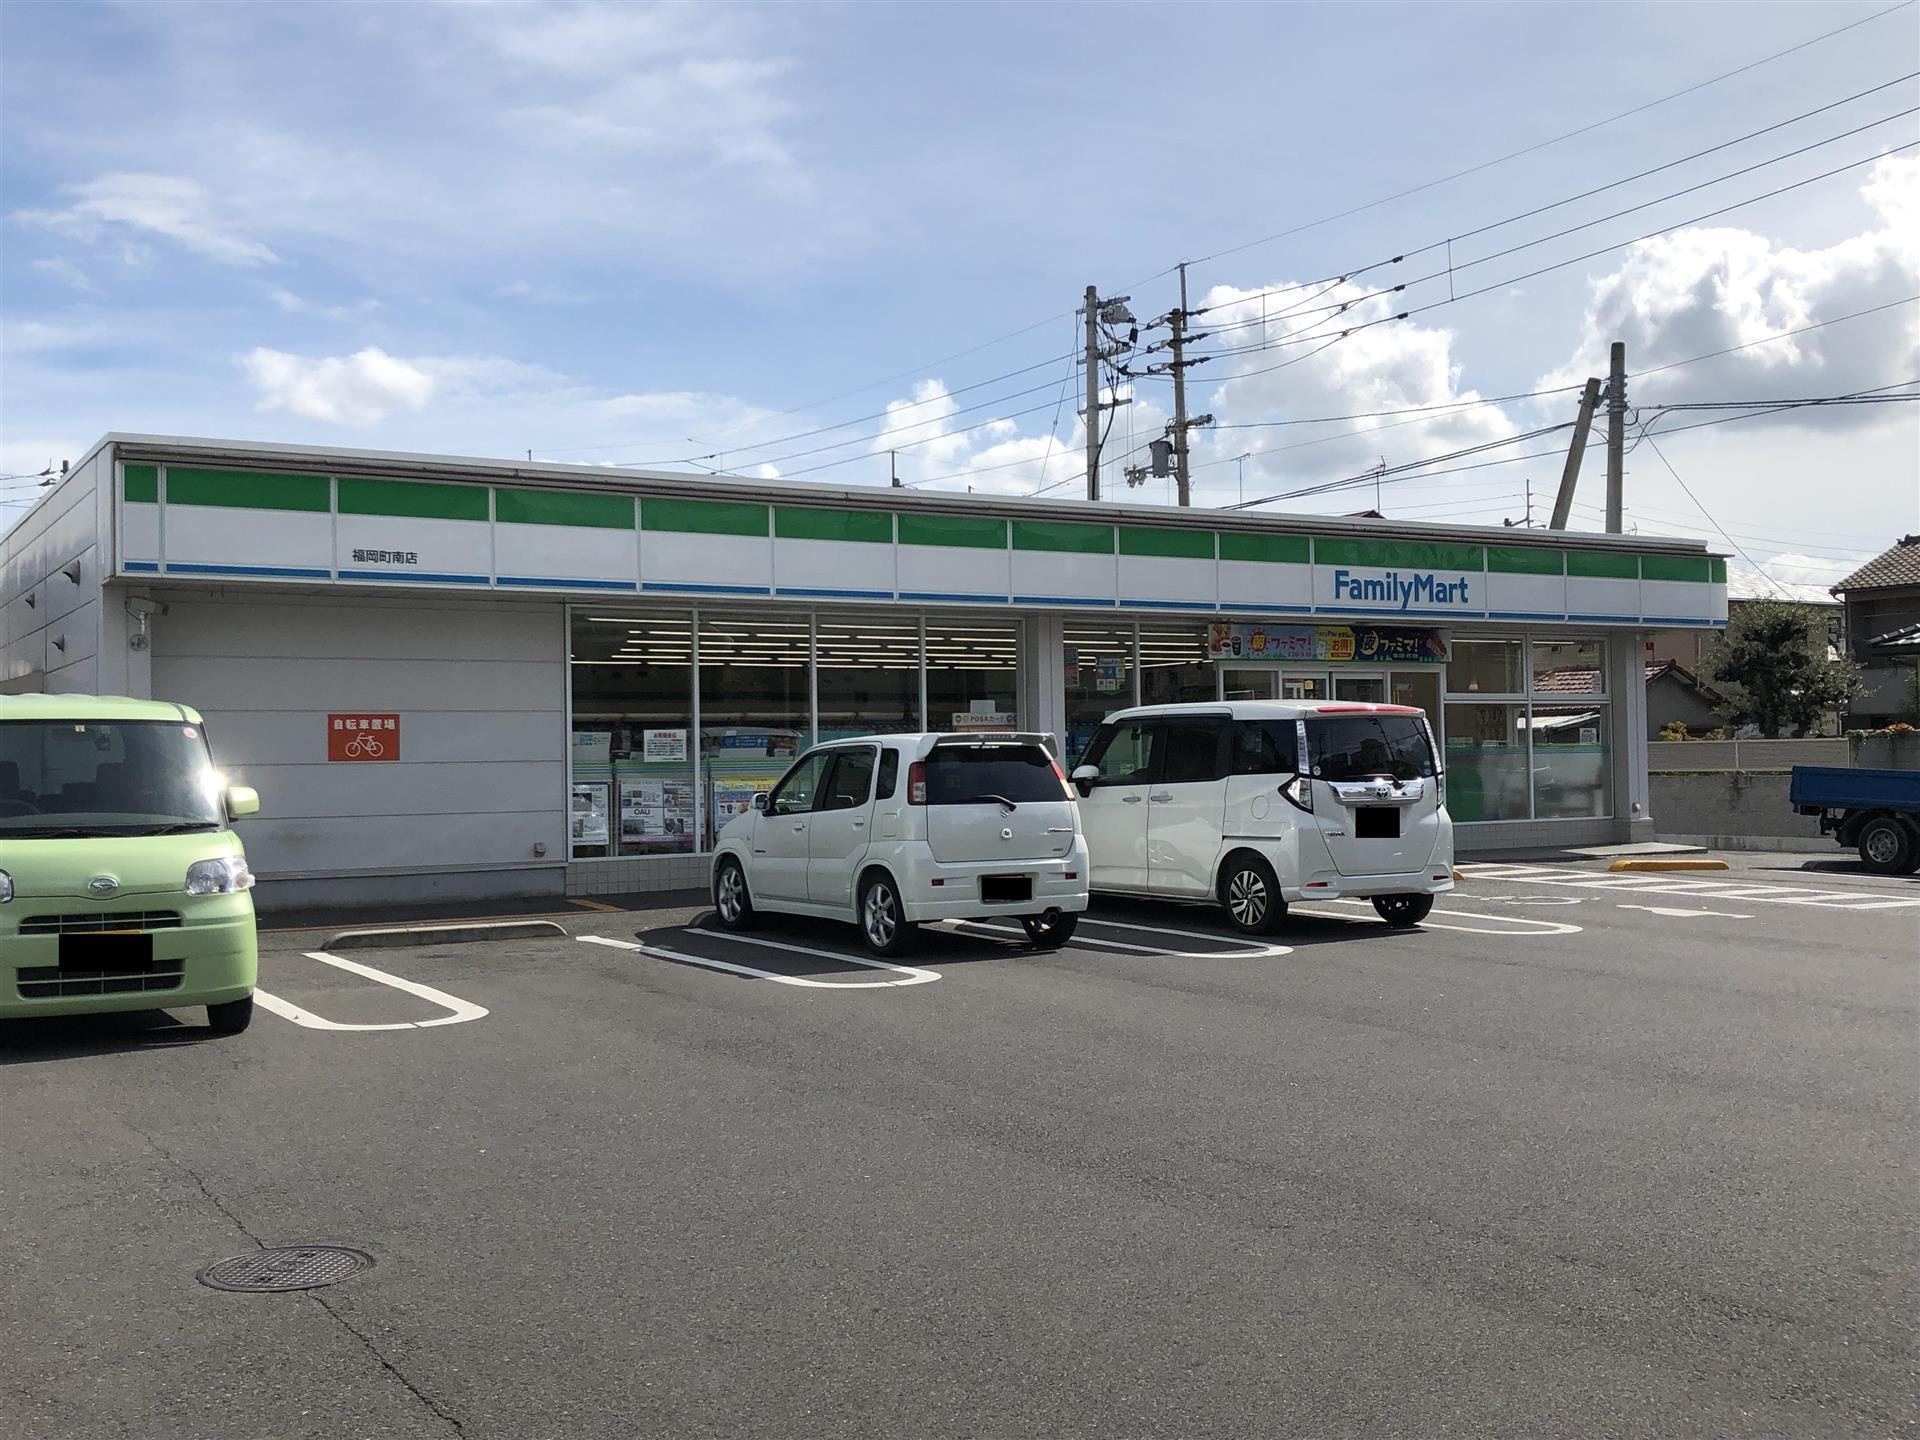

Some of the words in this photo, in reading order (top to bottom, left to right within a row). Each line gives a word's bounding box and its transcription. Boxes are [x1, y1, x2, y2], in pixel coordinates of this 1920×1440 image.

[352, 549, 418, 564] 福岡町南店
[1335, 570, 1468, 609] FamilyMart
[334, 719, 396, 730] 自転車置場
